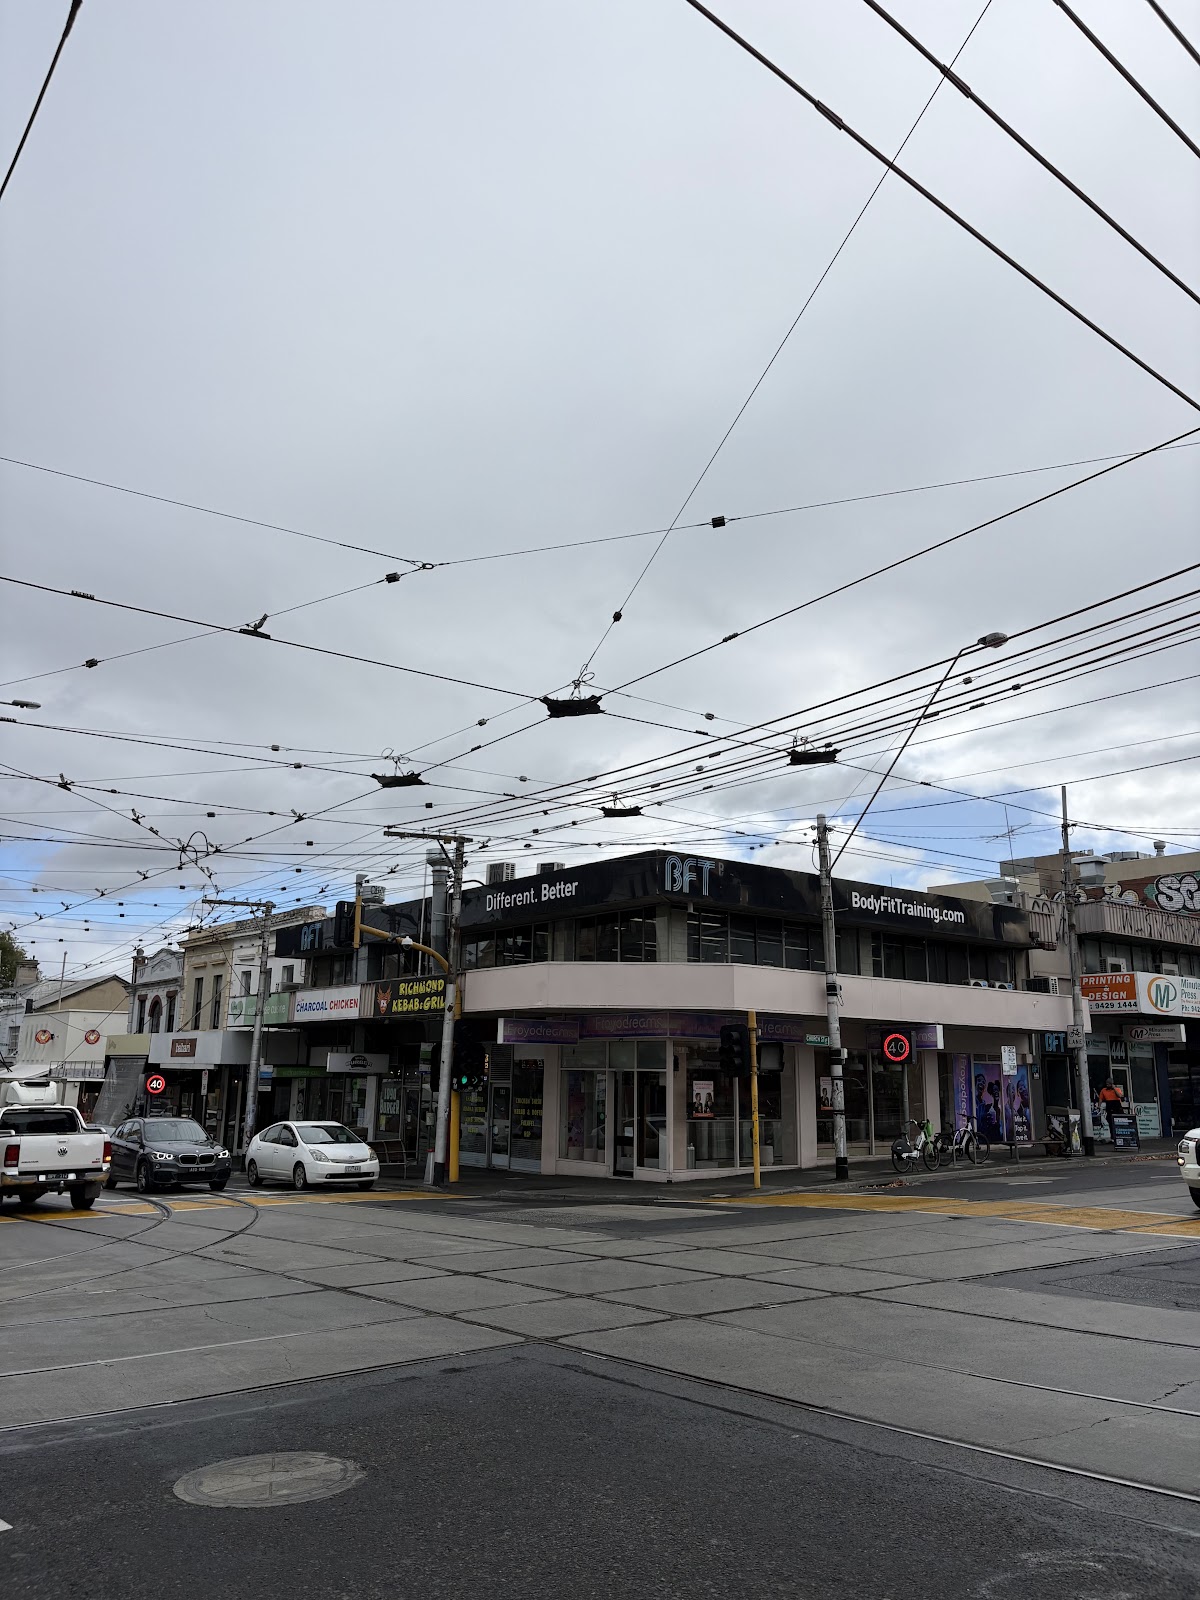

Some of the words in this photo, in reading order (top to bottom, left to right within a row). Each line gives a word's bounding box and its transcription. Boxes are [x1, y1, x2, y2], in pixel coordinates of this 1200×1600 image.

[665, 856, 716, 897] BFT
[486, 888, 538, 912] Different.
[541, 881, 579, 902] Better
[851, 891, 965, 924] BodyFitTraining.com
[300, 923, 322, 951] BFT
[399, 979, 445, 996] RICHMOND
[1082, 975, 1131, 986] PRINTING
[424, 996, 446, 1011] GRIL
[1089, 991, 1127, 1001] DESIGN
[296, 1001, 328, 1013] CHARCOAL
[329, 998, 359, 1011] CHICKEN
[1095, 1002, 1115, 1010] 9429
[1117, 1001, 1138, 1009] 1444
[507, 1024, 574, 1038] Froyodreams
[595, 1016, 663, 1033] Froyodreams
[888, 1041, 906, 1054] 40
[1111, 1041, 1125, 1060] 444
[150, 1079, 163, 1089] 40
[959, 1060, 968, 1127] Froyodream
